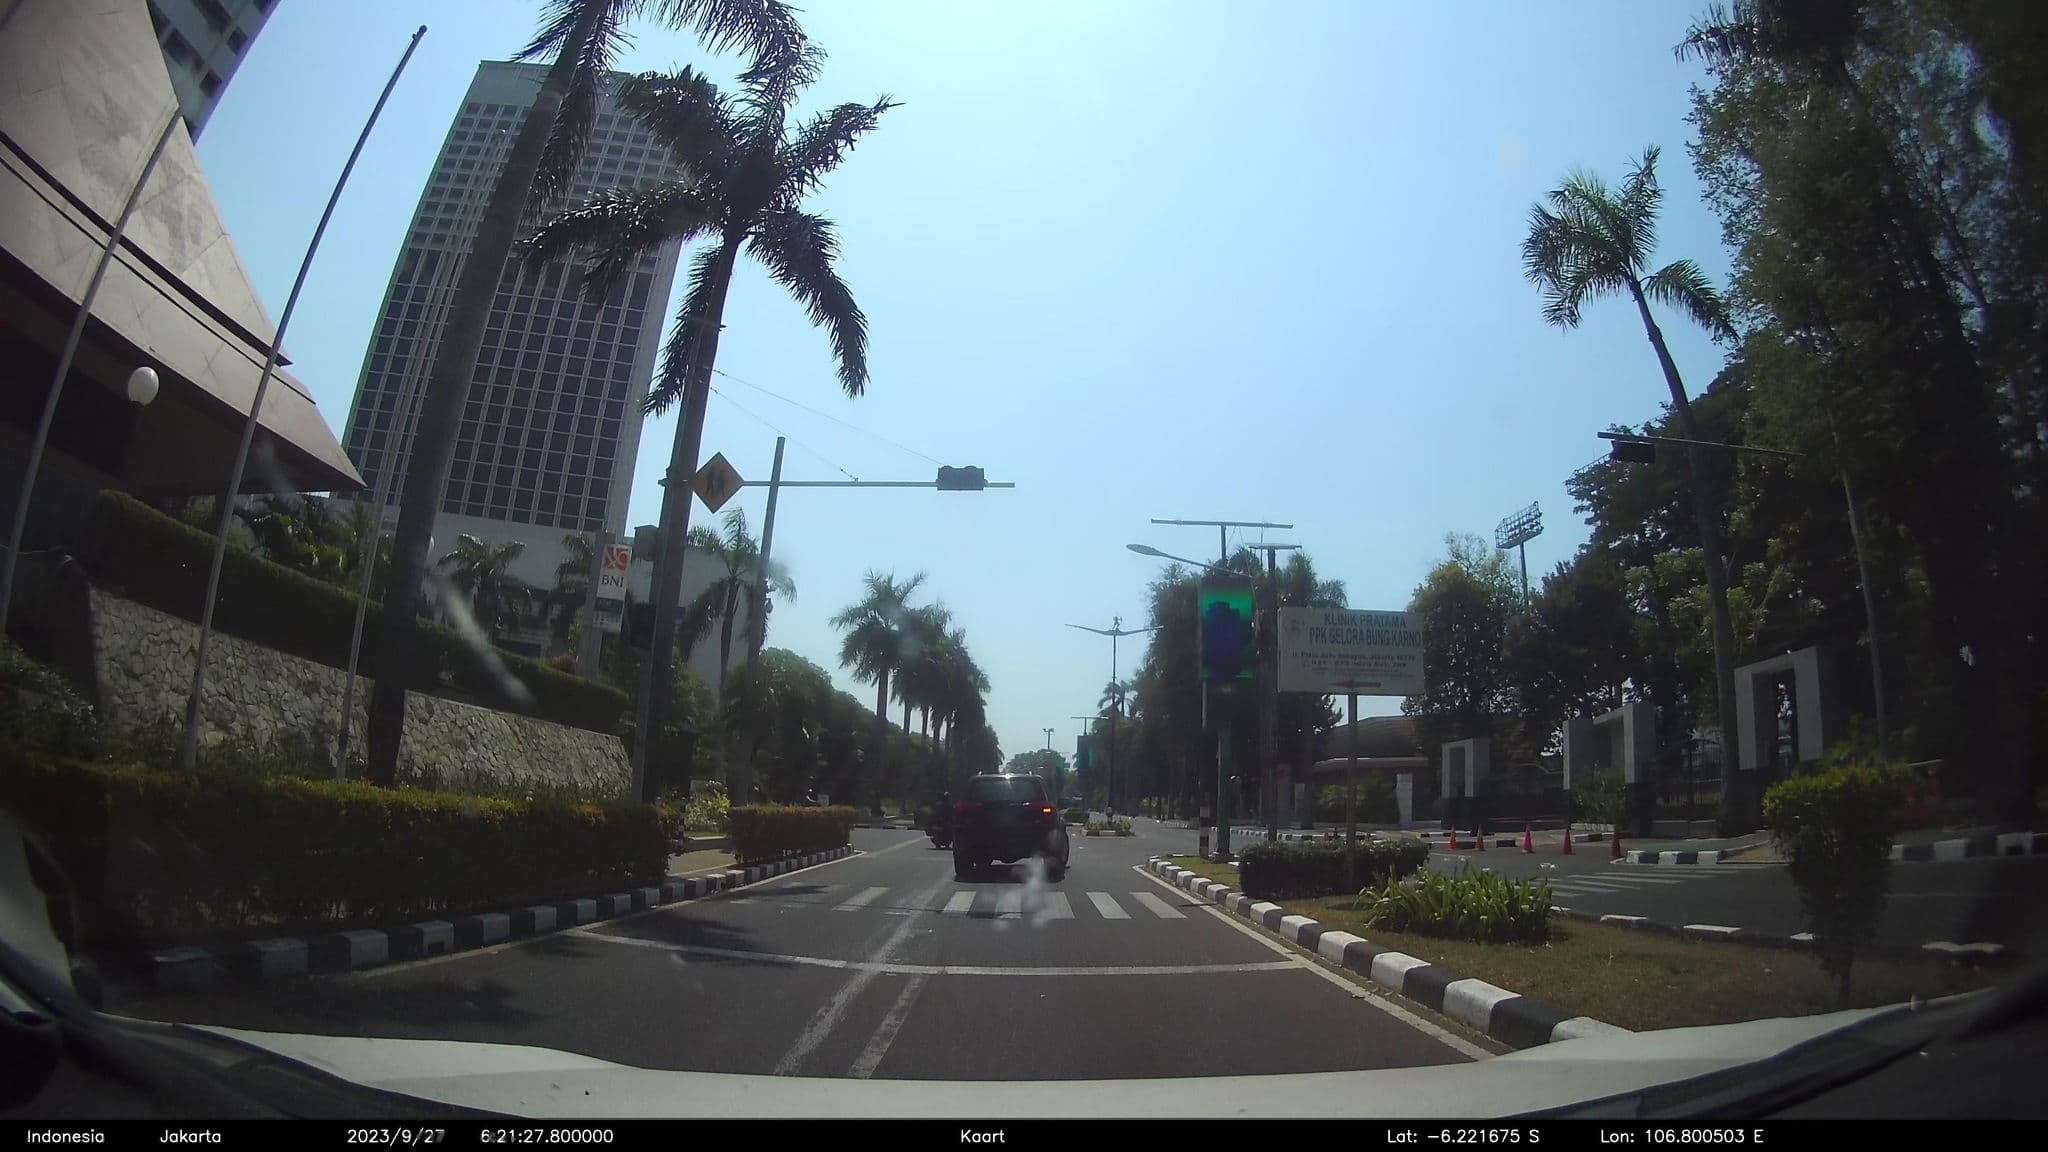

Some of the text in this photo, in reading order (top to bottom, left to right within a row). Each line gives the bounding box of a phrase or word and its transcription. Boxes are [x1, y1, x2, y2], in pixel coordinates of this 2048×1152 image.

[601, 574, 624, 588] BNI
[1324, 613, 1407, 628] KLINIK PRATAMA
[1309, 627, 1421, 648] PPK GELORA BUNG KARNO
